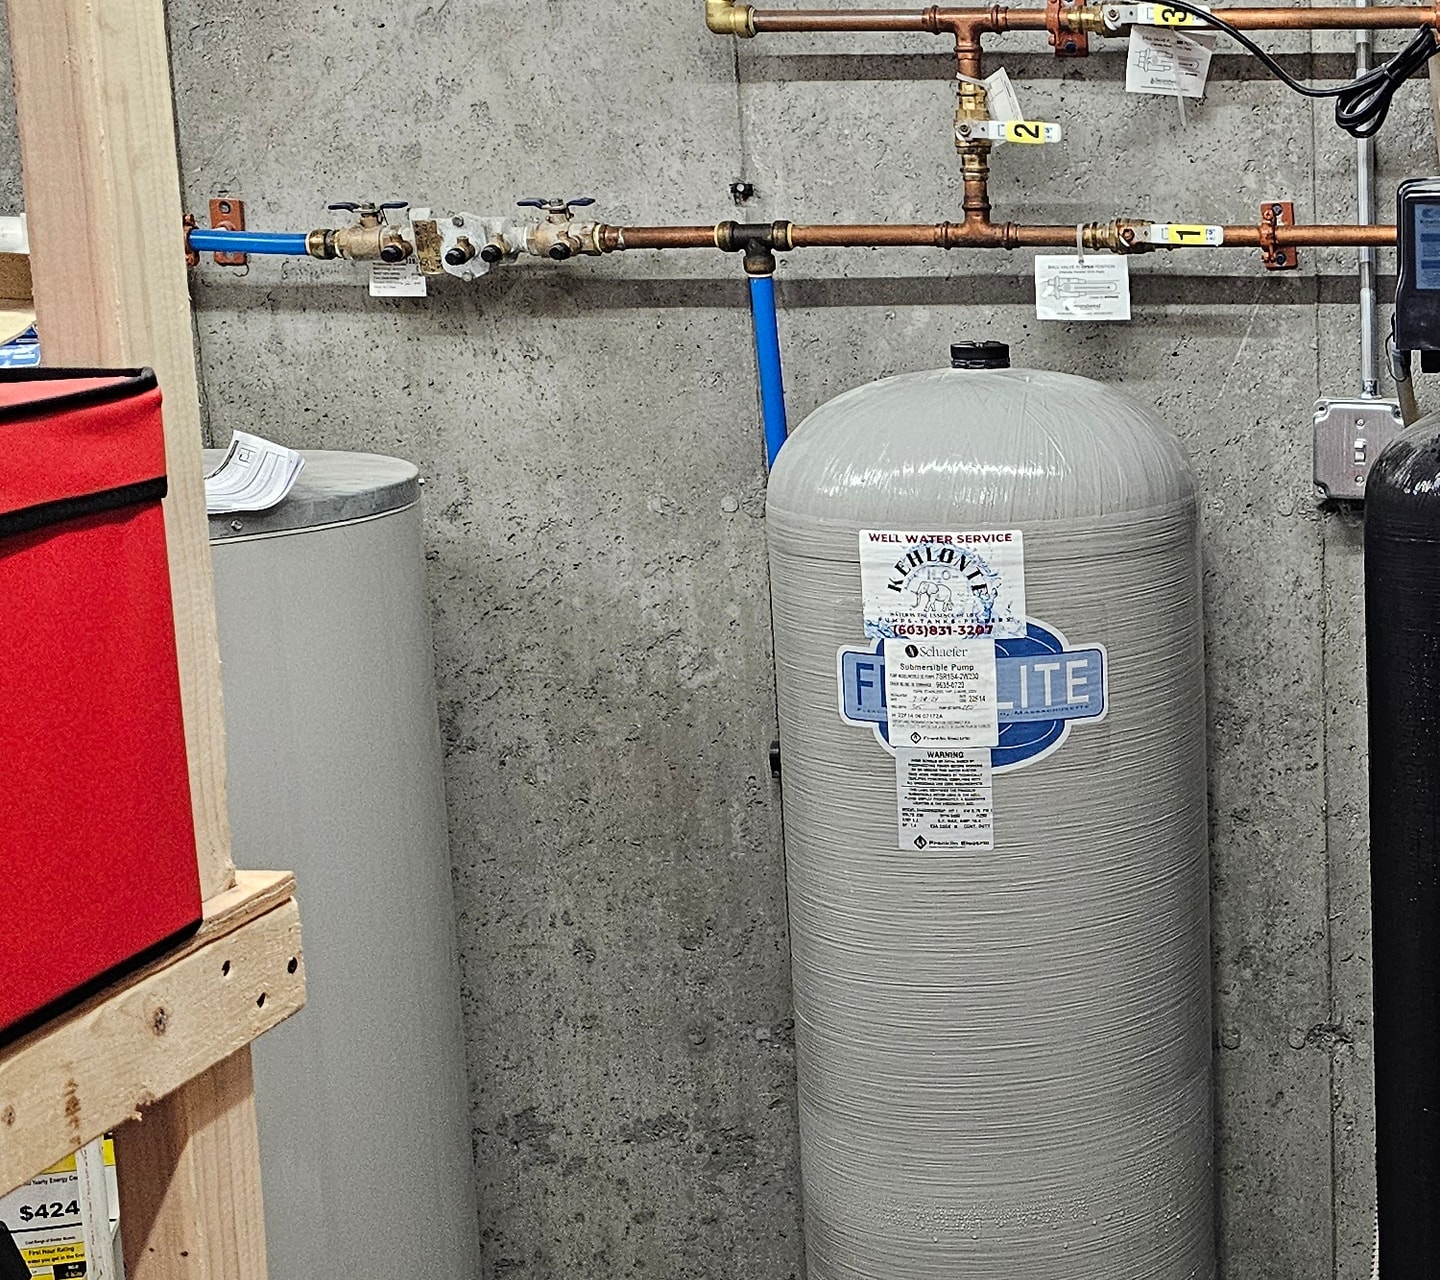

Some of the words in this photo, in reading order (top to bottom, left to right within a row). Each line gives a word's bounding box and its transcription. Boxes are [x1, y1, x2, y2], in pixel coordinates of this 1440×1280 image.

[1161, 8, 1187, 23] 3
[1014, 124, 1040, 139] 2
[1175, 229, 1201, 240] 1
[869, 533, 902, 543] WELL
[905, 534, 953, 544] WATER
[957, 533, 1013, 544] SERVICE
[893, 624, 994, 638] (603)831-3207
[920, 646, 968, 657] Schaefer
[900, 663, 948, 671] Submersible
[951, 664, 975, 672] Pump
[32, 1178, 48, 1186] Yearly
[50, 1176, 68, 1185] Energy
[19, 1199, 81, 1222] $424
[28, 1248, 41, 1256] First
[57, 1246, 74, 1254] Rating
